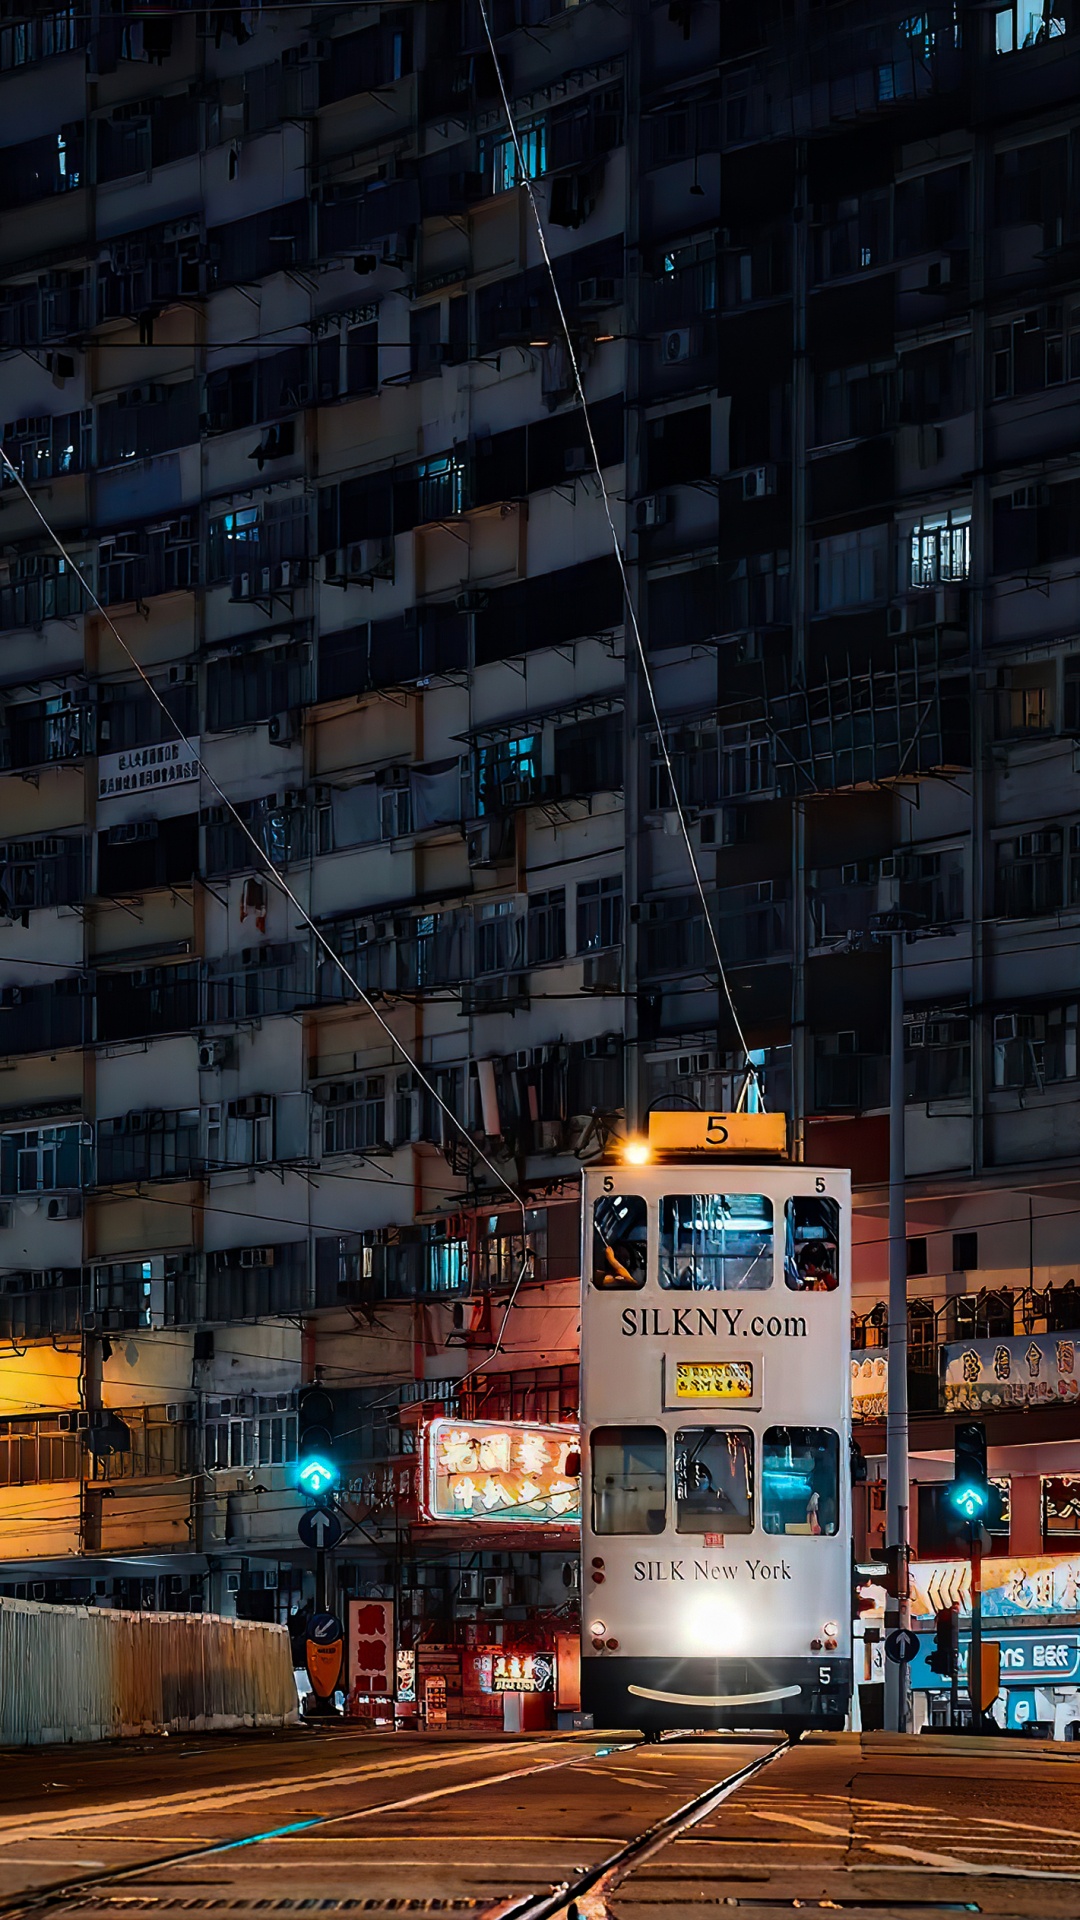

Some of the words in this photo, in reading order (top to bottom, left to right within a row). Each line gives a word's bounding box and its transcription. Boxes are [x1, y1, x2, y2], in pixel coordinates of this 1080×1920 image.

[706, 1116, 729, 1145] 5
[603, 1176, 614, 1192] 5
[815, 1177, 826, 1193] 5
[621, 1308, 807, 1337] SILKNY.com
[634, 1560, 685, 1581] SILK
[694, 1560, 738, 1580] New
[745, 1559, 792, 1580] York
[819, 1667, 832, 1685] 5
